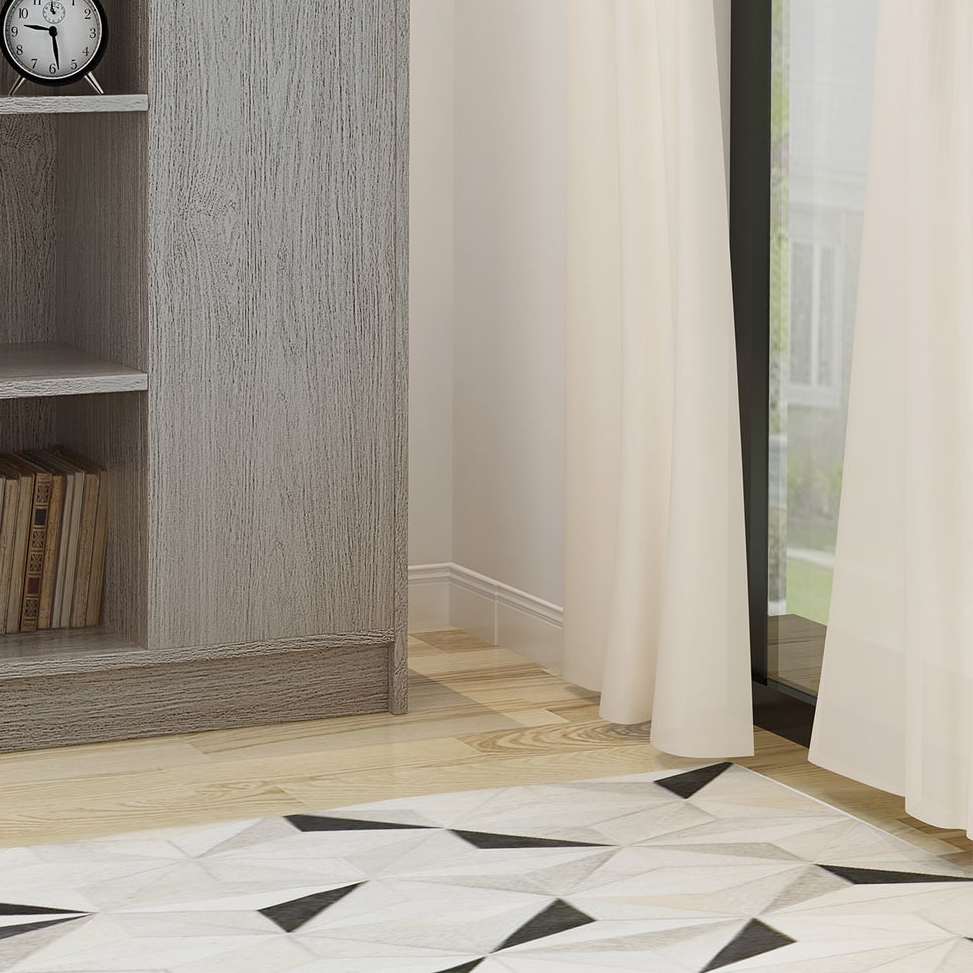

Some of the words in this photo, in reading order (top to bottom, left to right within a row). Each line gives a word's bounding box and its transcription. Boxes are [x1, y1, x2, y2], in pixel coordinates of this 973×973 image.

[18, 8, 29, 19] 10
[84, 9, 91, 20] 2
[11, 27, 18, 37] 9
[89, 28, 97, 39] 3
[16, 45, 24, 55] 8
[82, 46, 90, 56] 4
[30, 58, 38, 69] 7
[49, 63, 56, 74] 6
[70, 59, 78, 70] 5
